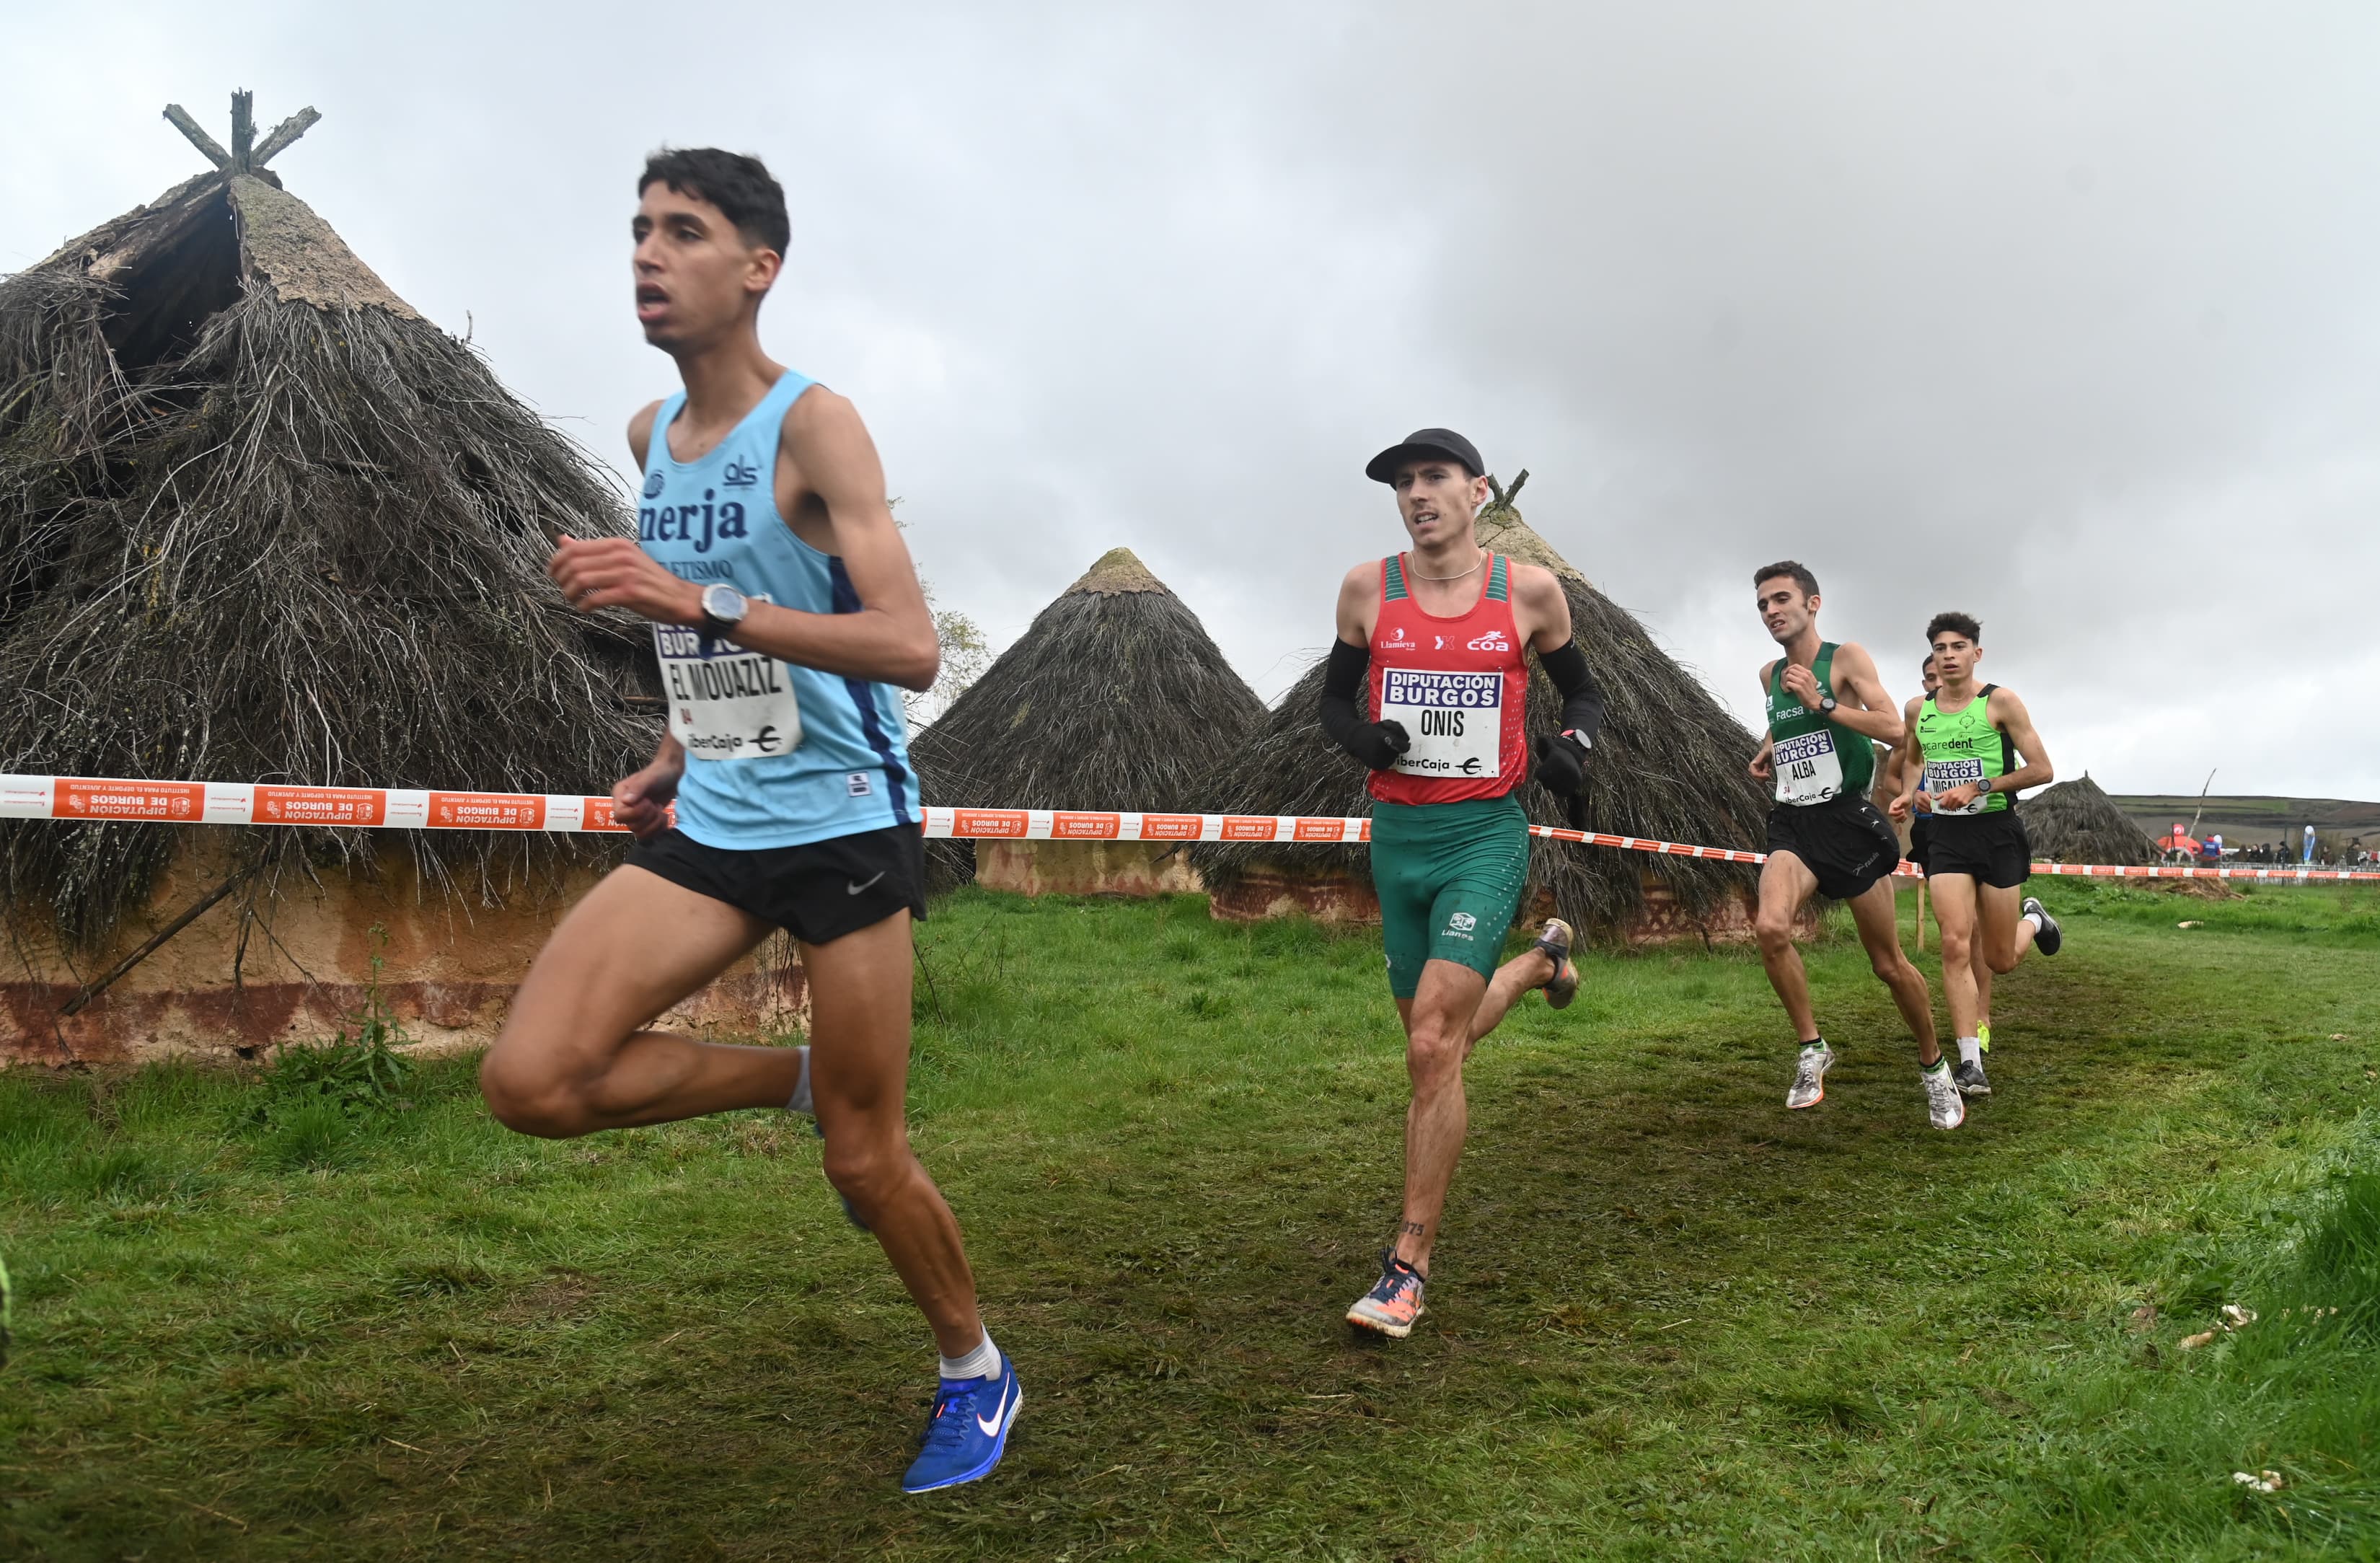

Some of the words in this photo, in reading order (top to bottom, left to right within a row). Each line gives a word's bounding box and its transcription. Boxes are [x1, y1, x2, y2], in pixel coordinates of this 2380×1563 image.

[640, 488, 749, 554] nerja
[669, 664, 691, 700] EL
[1390, 672, 1496, 690] DIPUTACIÓN
[1389, 686, 1494, 706] BURGOS
[1421, 709, 1464, 736] ONIS
[1776, 741, 1830, 765] BURGOS
[1791, 760, 1816, 780] ALBA
[1929, 767, 1979, 778] BURGOS
[91, 795, 144, 804] BURGOS
[151, 797, 167, 806] DE
[90, 805, 166, 815] DIPUTACIÓN
[286, 801, 332, 810] BURGOS
[457, 806, 499, 815] BURGOS
[285, 811, 353, 820] DIPUTACIÓN
[456, 816, 516, 824] DIPUTACIÓN
